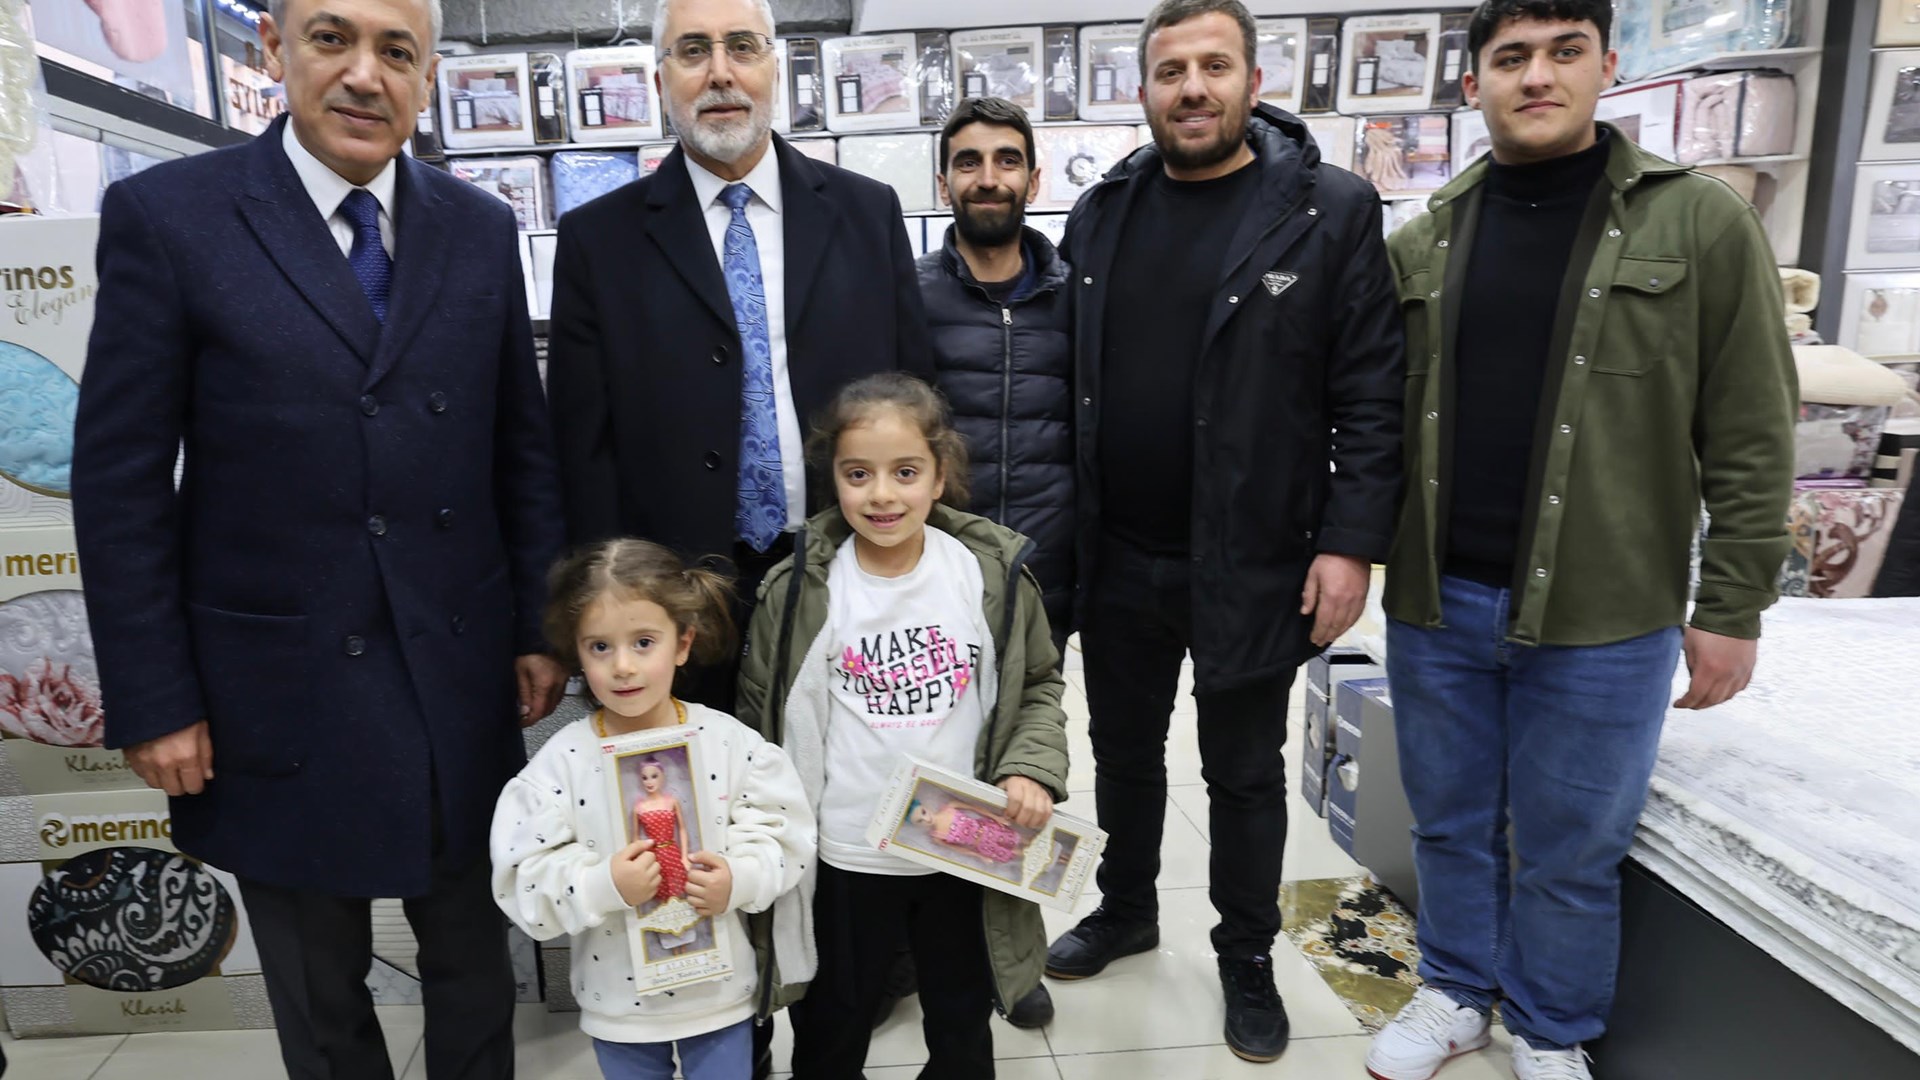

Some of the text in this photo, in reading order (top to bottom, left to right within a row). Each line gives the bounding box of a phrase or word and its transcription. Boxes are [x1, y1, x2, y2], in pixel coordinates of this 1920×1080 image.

[0, 265, 74, 291] inos
[6, 552, 76, 577] meri
[861, 625, 947, 667] MAKE
[865, 676, 958, 716] HAPPY
[121, 999, 187, 1016] Klasik
